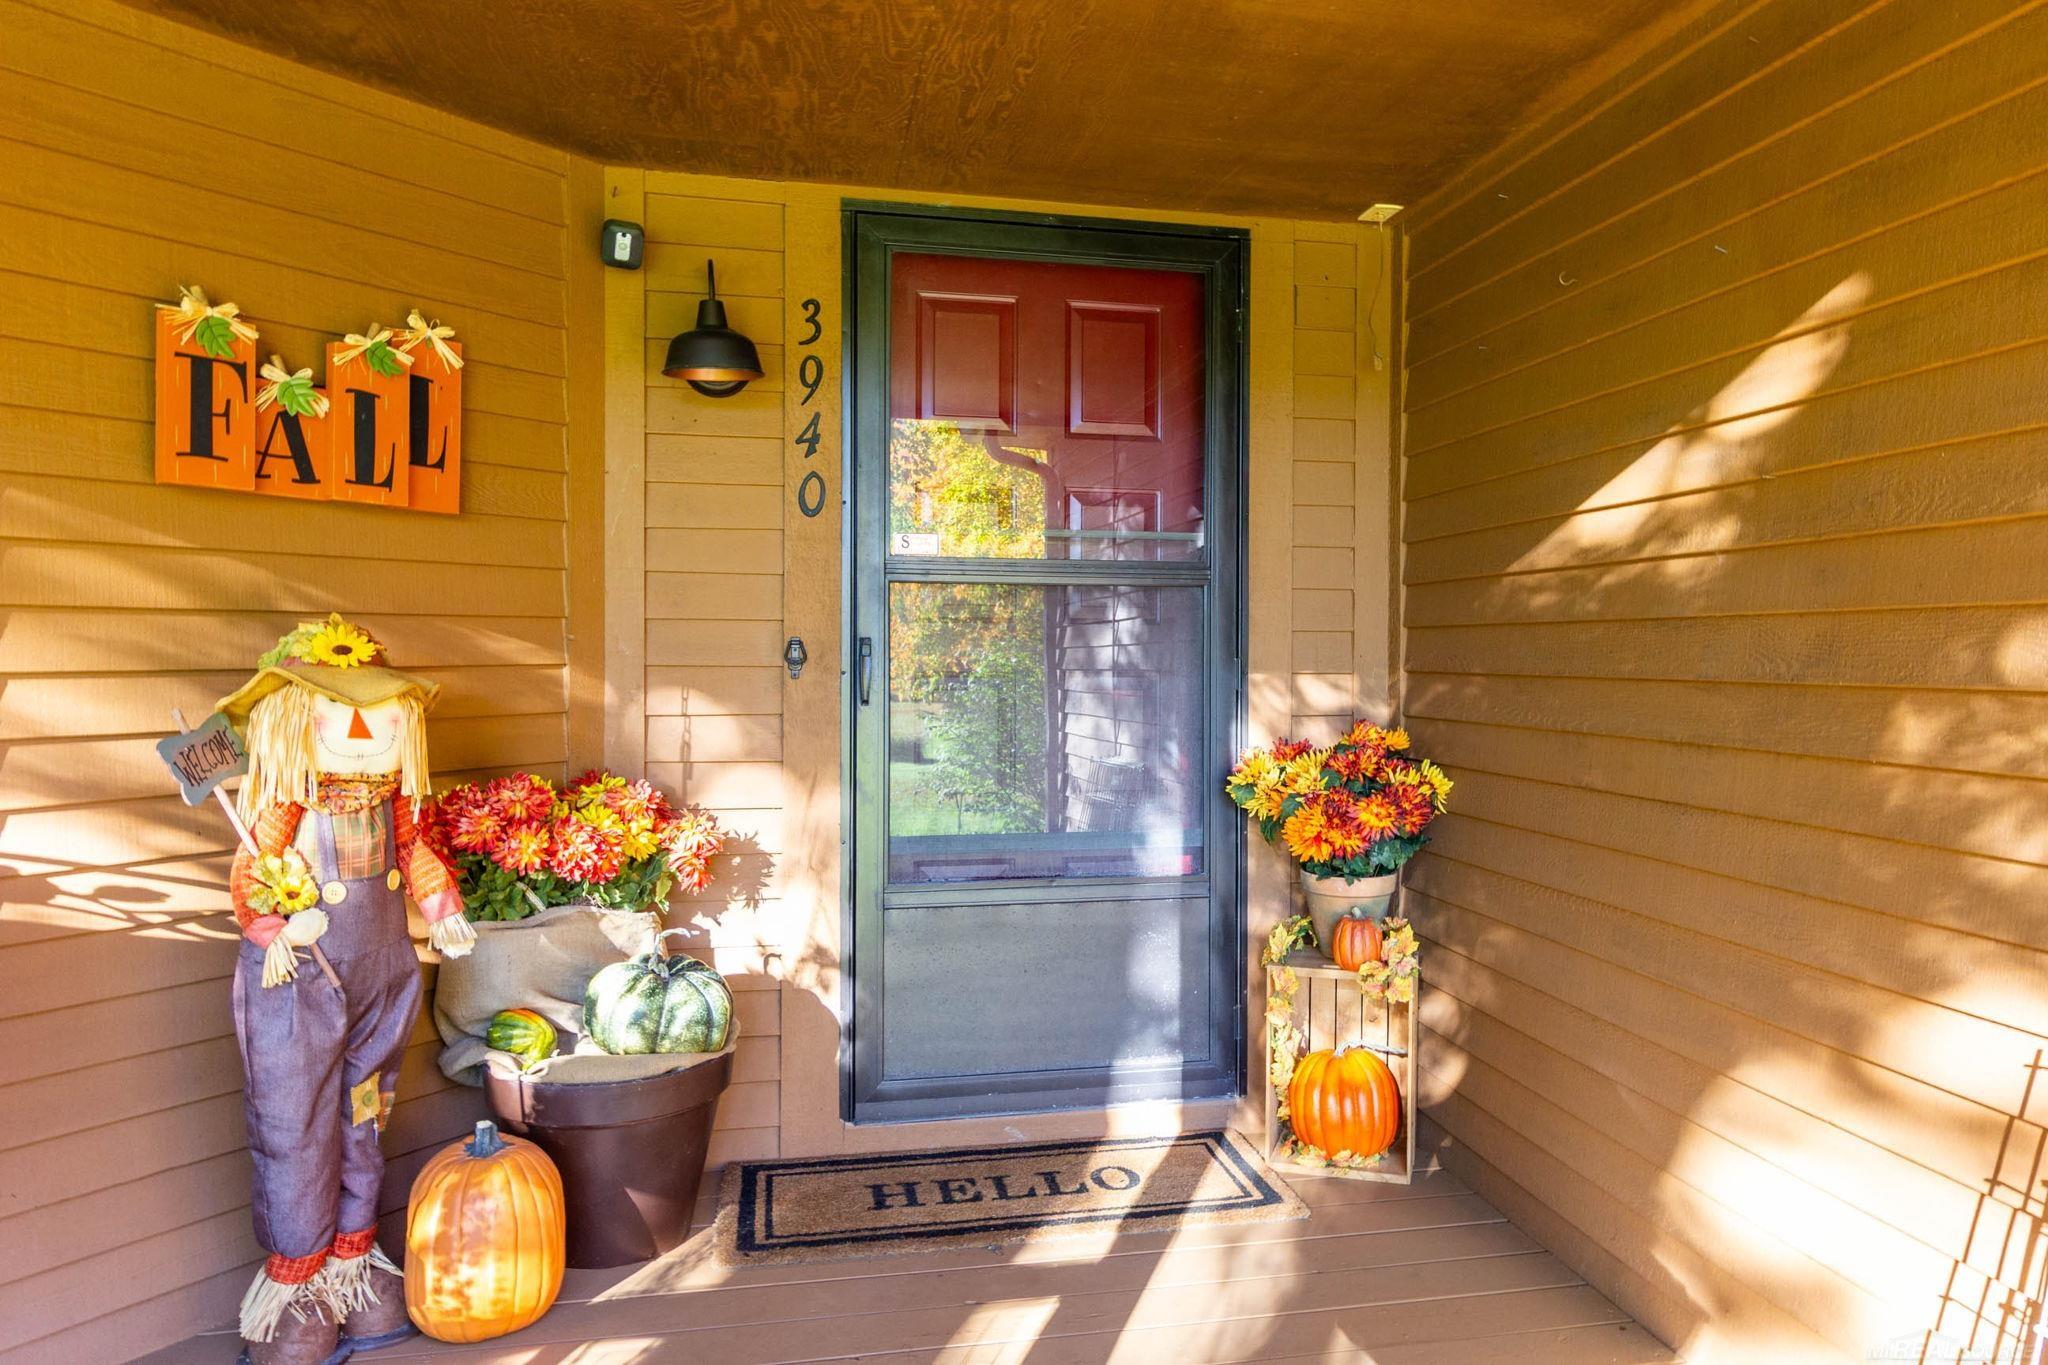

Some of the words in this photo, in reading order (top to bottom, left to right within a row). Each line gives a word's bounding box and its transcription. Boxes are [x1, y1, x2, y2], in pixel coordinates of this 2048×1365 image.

[174, 351, 447, 492] FALL
[796, 298, 826, 517] 3940
[173, 725, 244, 787] WELCOME
[864, 1165, 1141, 1211] HELLO
